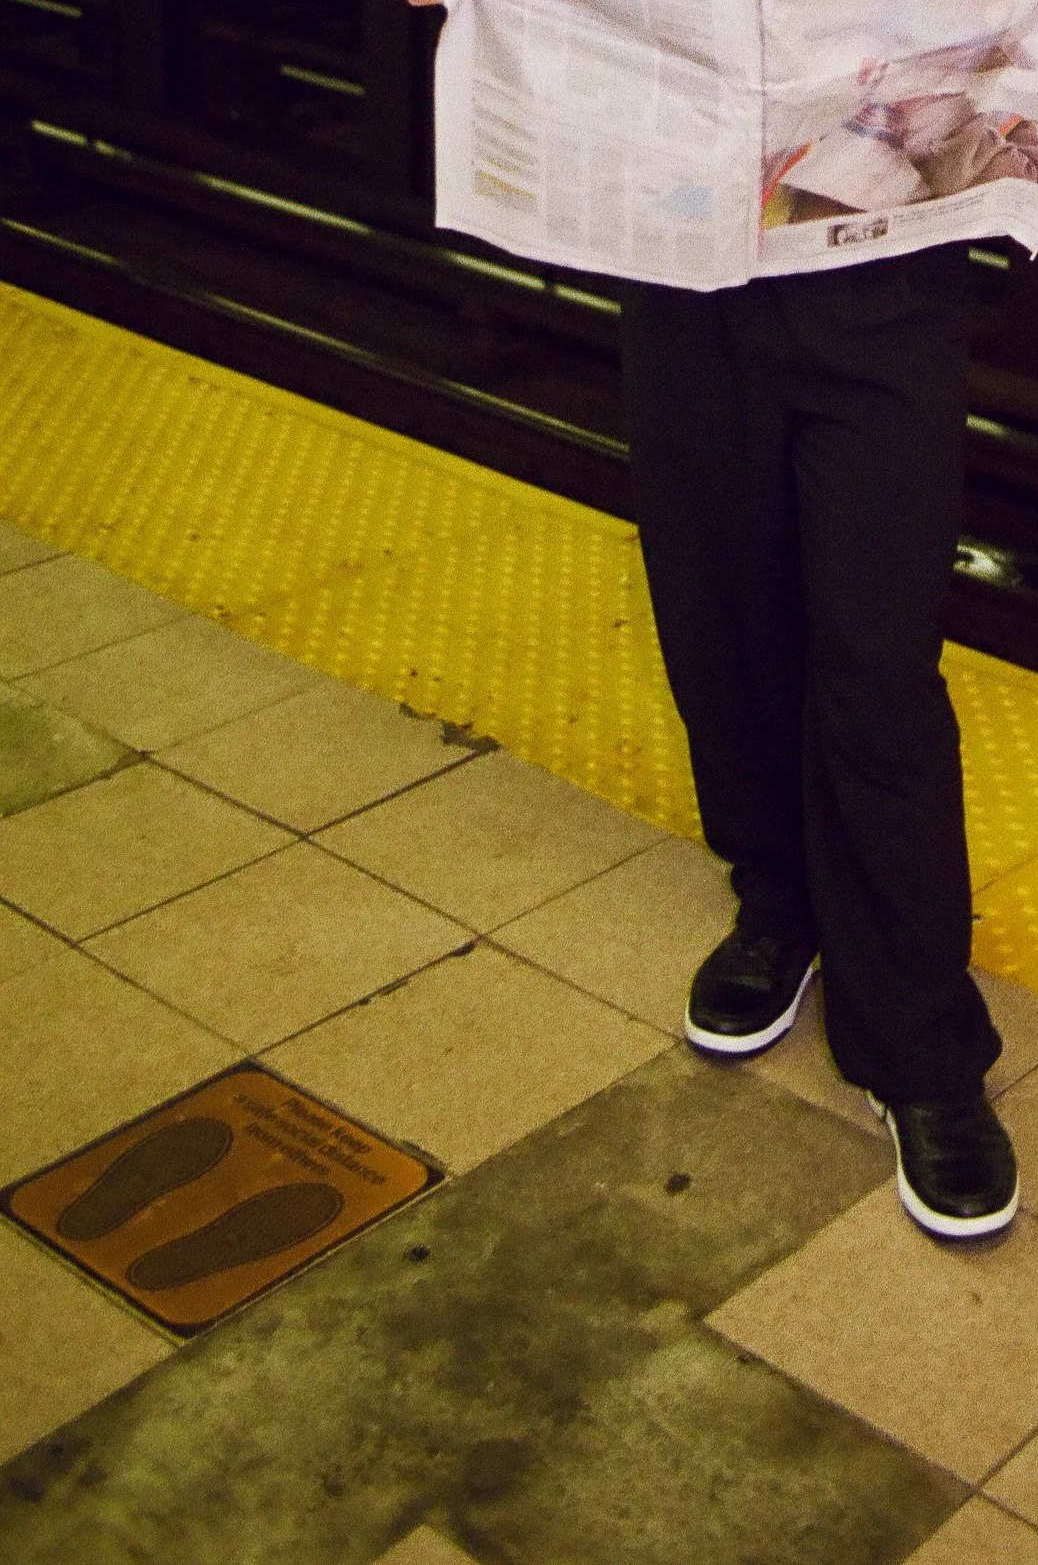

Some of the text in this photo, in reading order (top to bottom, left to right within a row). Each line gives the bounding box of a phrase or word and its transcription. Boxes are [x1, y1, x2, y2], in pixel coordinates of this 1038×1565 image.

[283, 1096, 372, 1155] Please keep
[318, 1143, 387, 1185] distance
